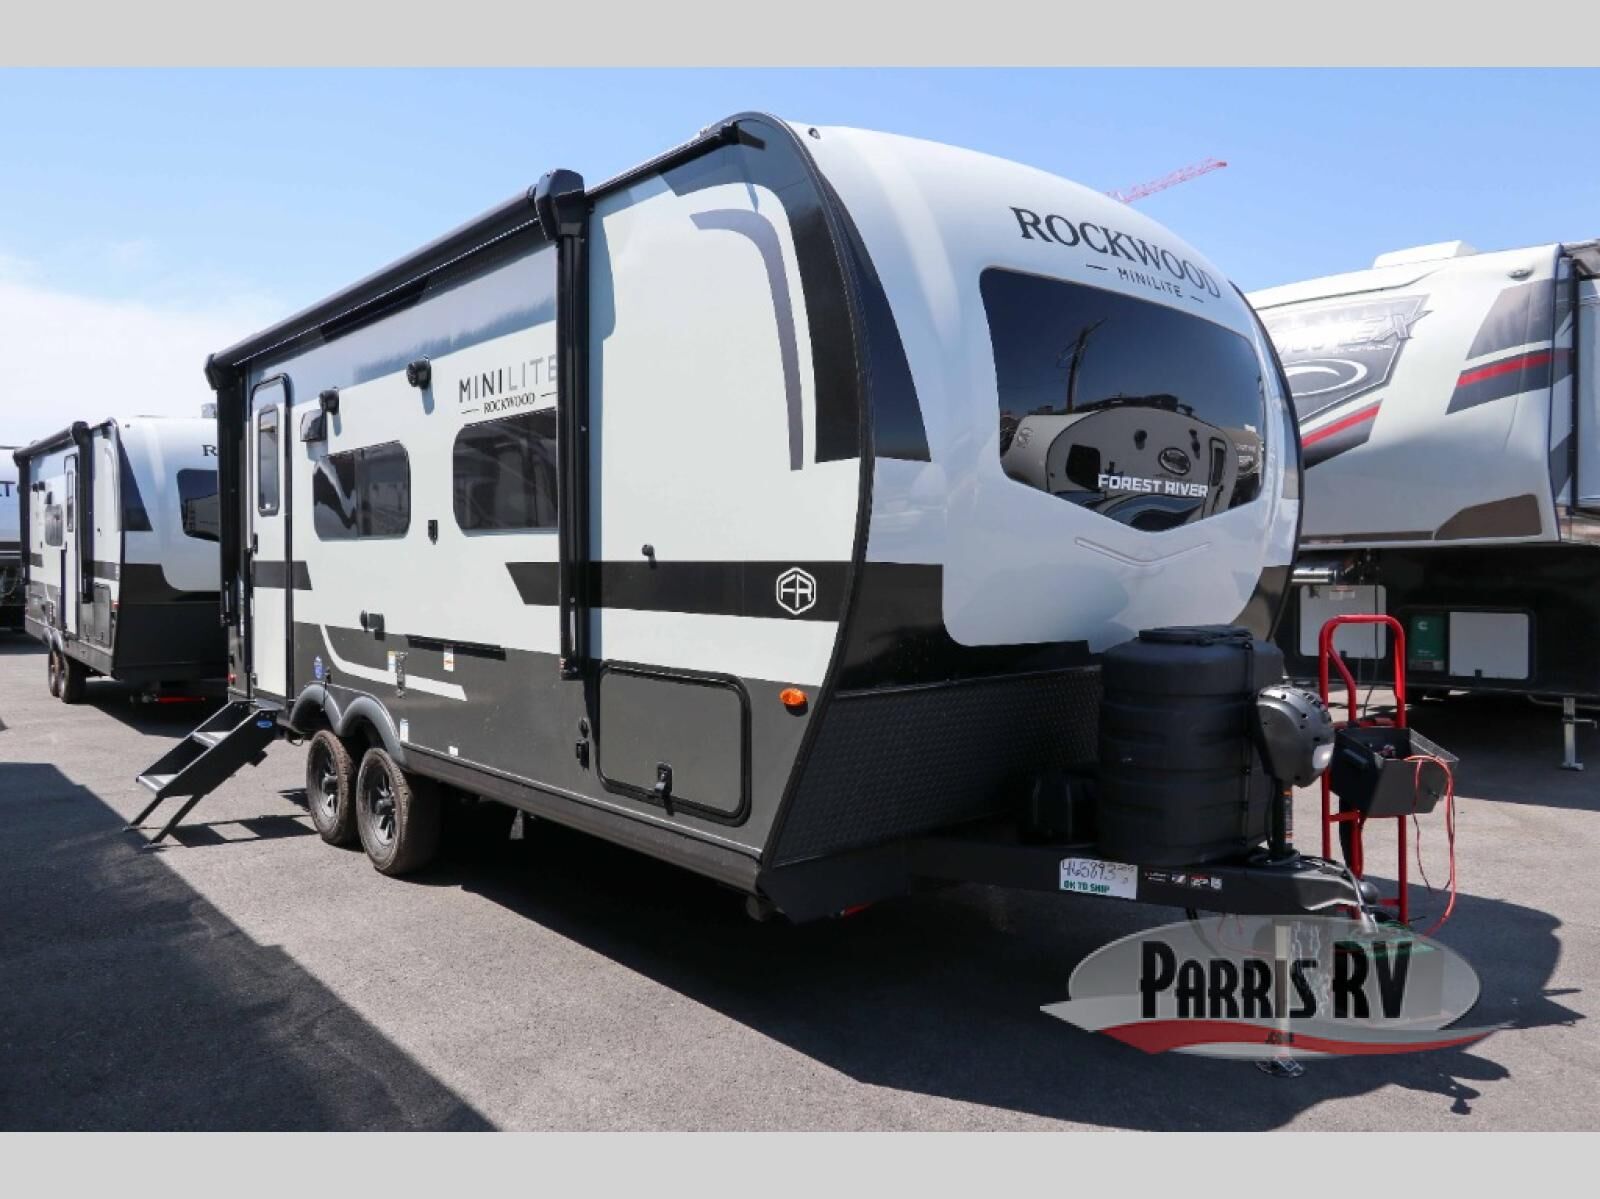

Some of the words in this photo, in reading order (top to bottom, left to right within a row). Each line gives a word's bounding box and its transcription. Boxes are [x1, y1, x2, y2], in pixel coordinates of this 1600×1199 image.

[1009, 206, 1221, 298] ROCKWOOD
[1117, 267, 1183, 298] MINILITE
[484, 393, 535, 414] ROCKWOOD
[1097, 473, 1162, 493] FOREST
[1164, 480, 1209, 498] RIVER
[1090, 883, 1111, 894] SHIP
